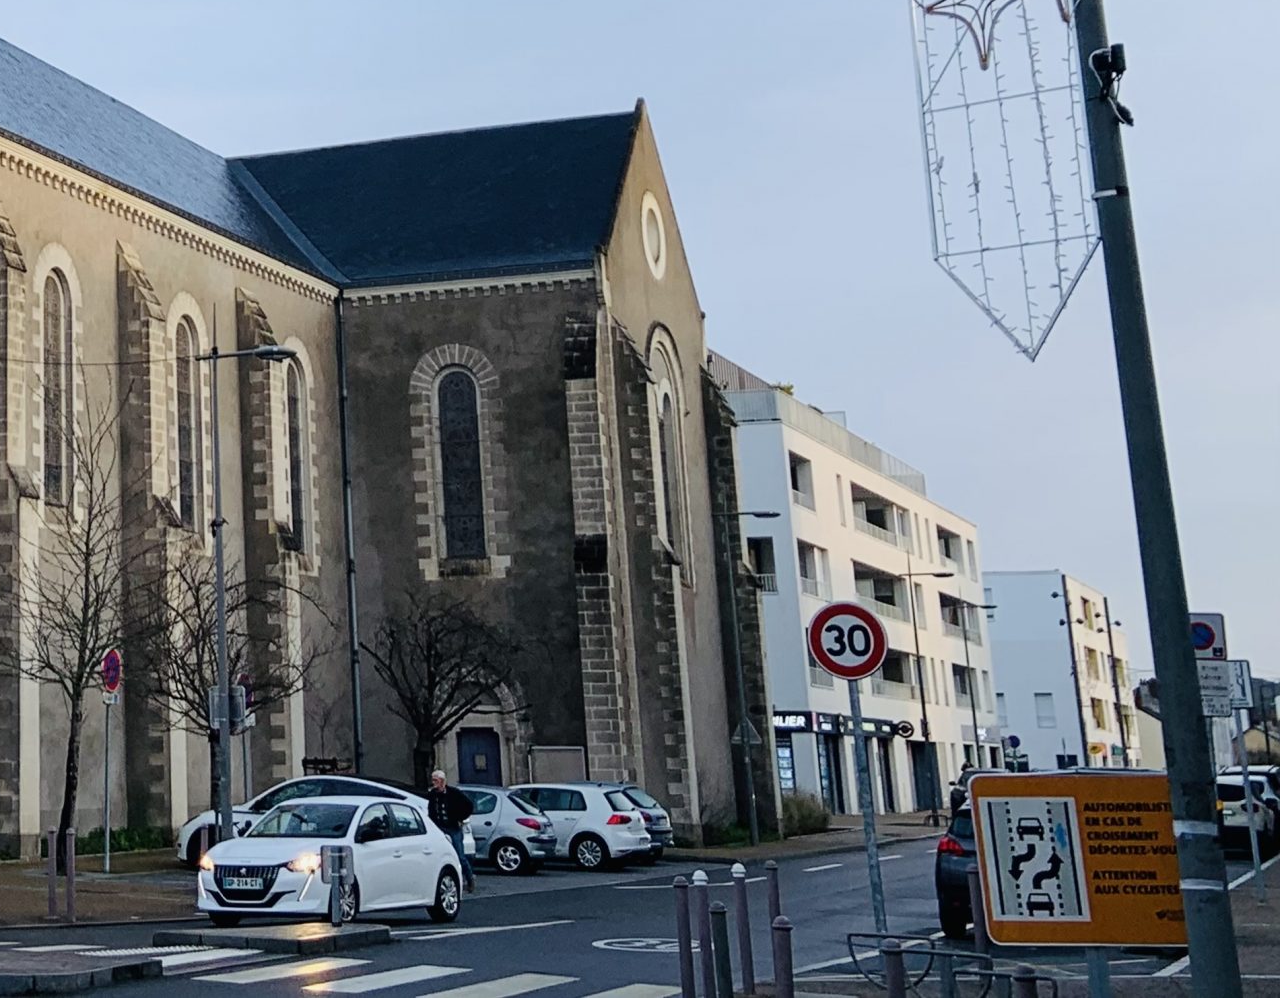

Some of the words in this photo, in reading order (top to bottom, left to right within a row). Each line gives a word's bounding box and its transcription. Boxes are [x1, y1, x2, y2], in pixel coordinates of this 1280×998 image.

[824, 624, 871, 657] 30
[1083, 802, 1172, 812] AUTOMOBILIST
[1085, 817, 1100, 826] EN
[1103, 817, 1125, 826] CAS
[1127, 817, 1142, 826] DE
[1087, 831, 1159, 841] CROISEMENT
[1088, 842, 1177, 855] DÉPORTEZ-VOU
[1093, 870, 1158, 880] ATTENTION
[1095, 884, 1120, 894] AUX
[1122, 884, 1180, 895] CYCLISTES
